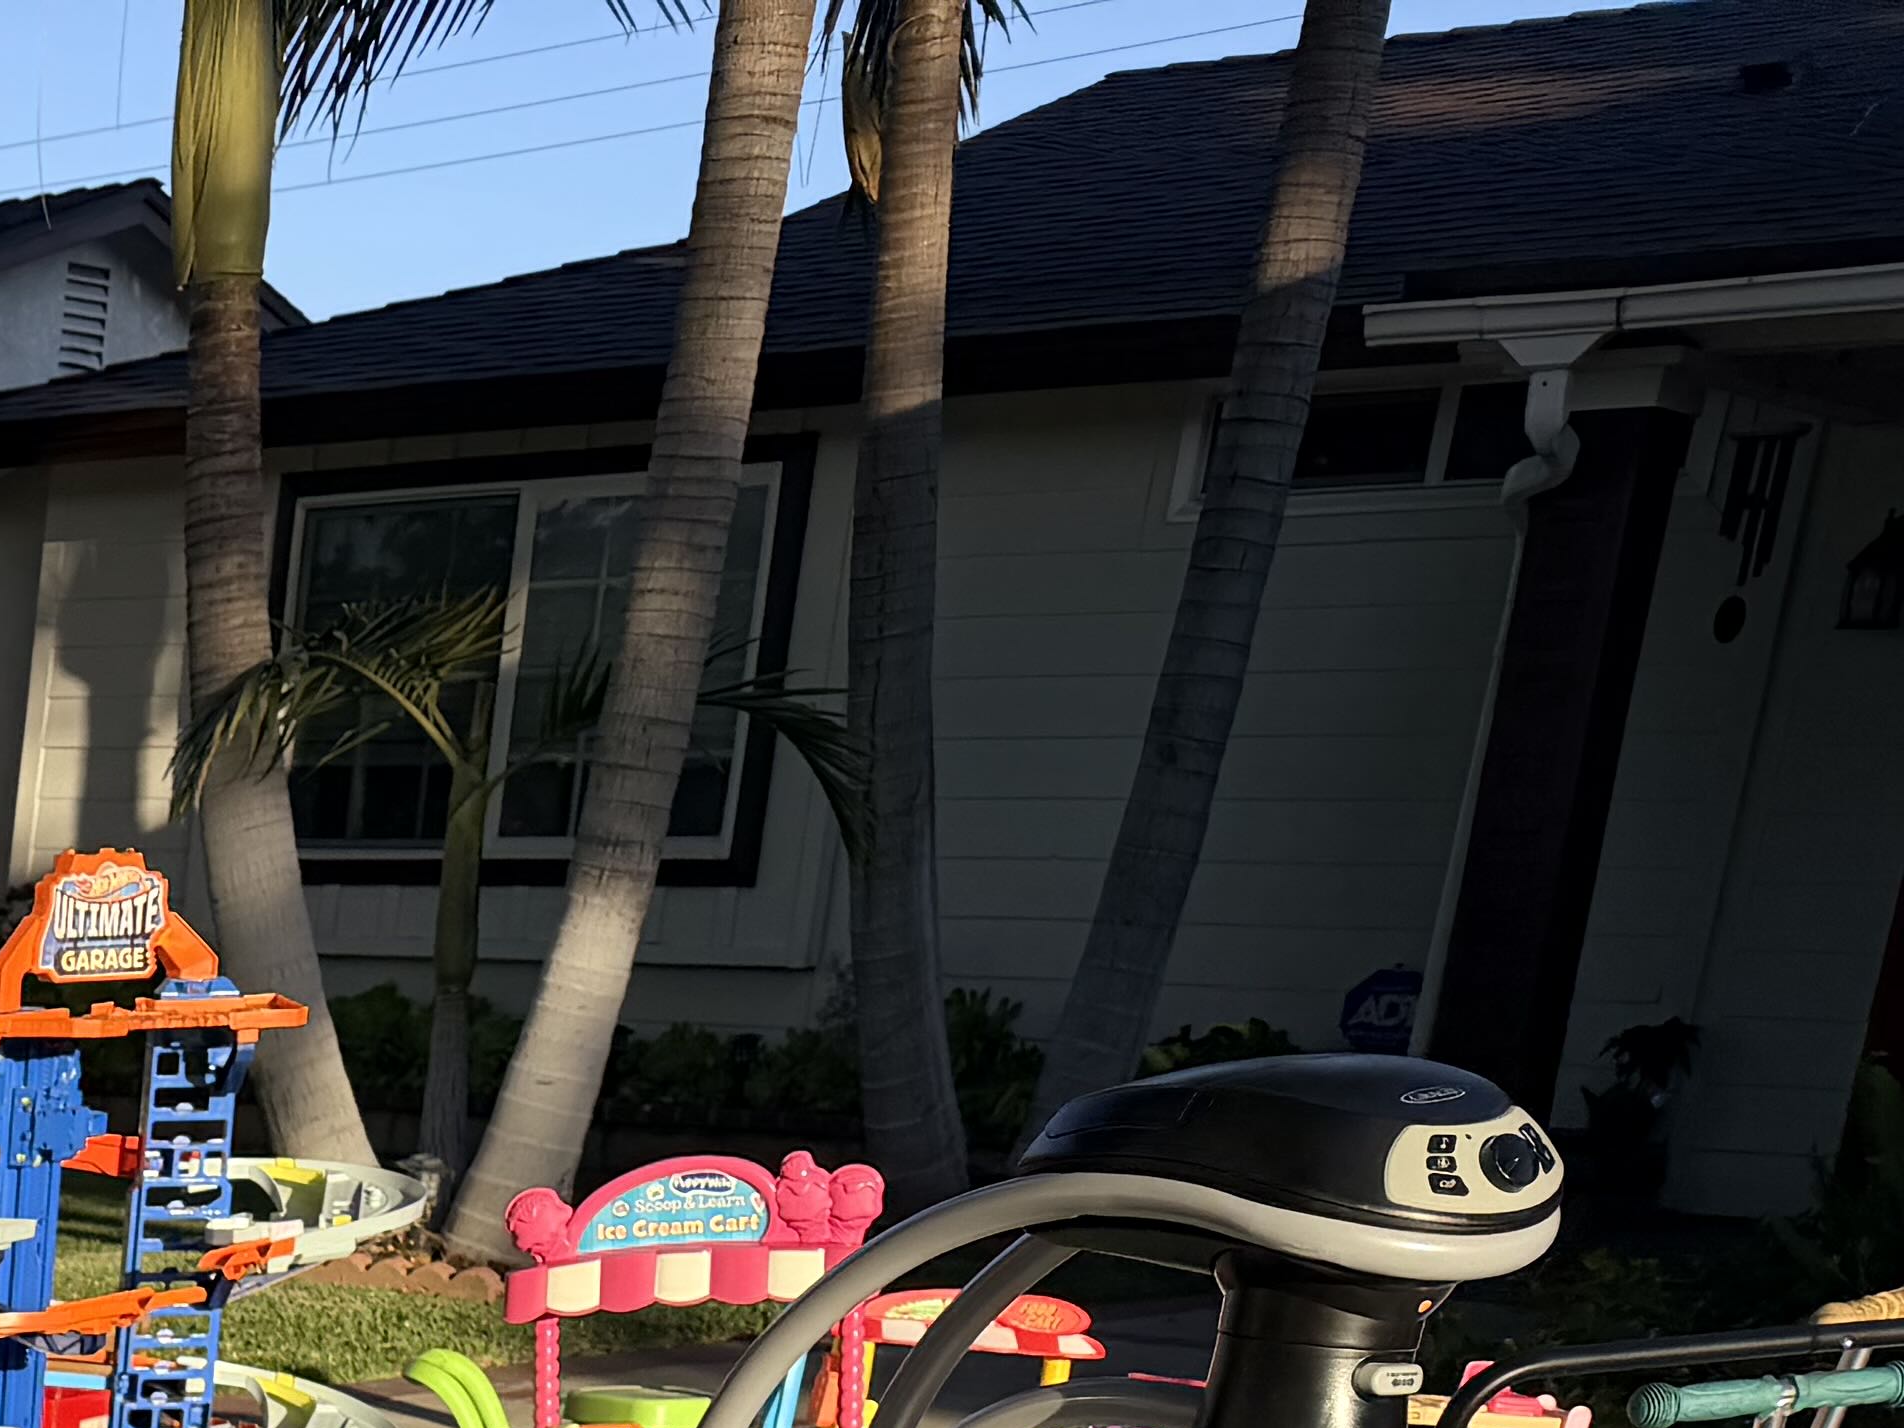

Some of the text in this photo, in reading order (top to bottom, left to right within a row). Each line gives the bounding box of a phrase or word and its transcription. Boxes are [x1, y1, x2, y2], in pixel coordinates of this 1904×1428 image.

[53, 886, 160, 939] ULTIMATE
[61, 947, 144, 972] GARAGE
[634, 1194, 745, 1214] Scoop & Learn
[597, 1214, 760, 1240] Ice Cream Cart
